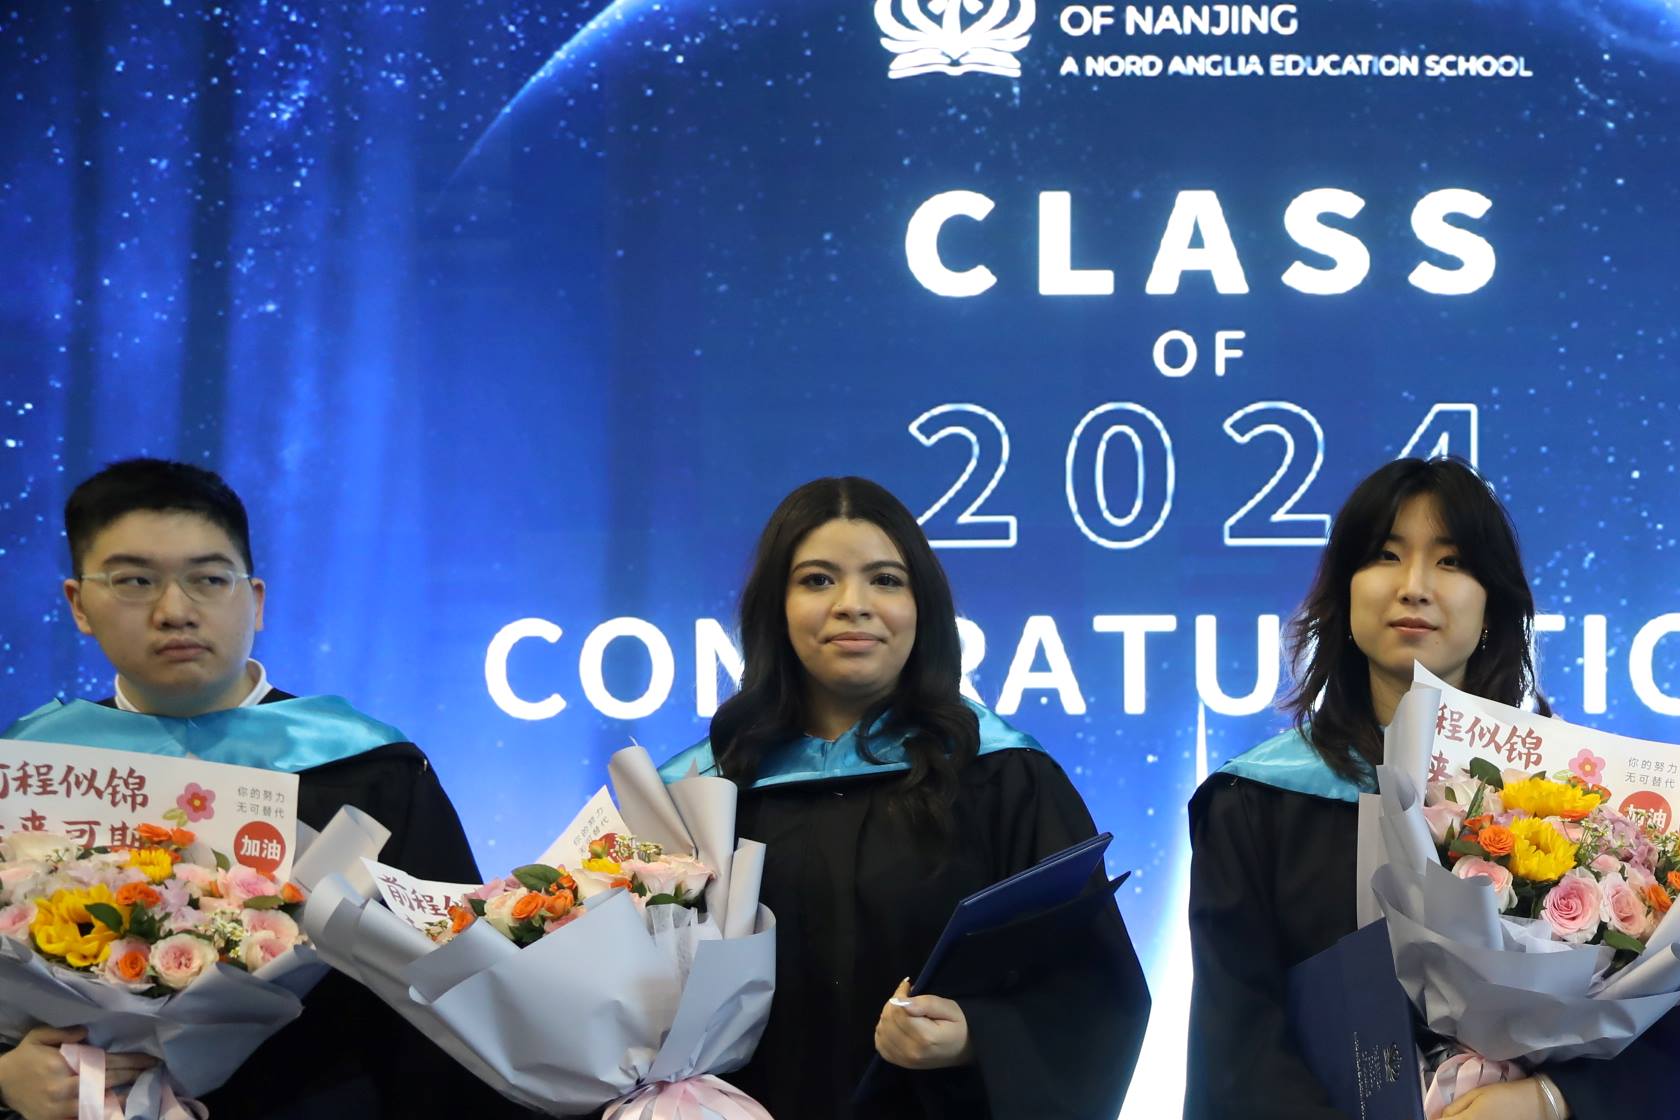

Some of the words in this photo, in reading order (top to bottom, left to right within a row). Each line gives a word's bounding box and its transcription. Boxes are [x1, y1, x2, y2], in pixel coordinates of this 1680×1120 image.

[1059, 4, 1114, 36] OF
[1124, 4, 1298, 36] NANJING
[1059, 55, 1080, 77] A
[1085, 55, 1163, 77] NORD
[1168, 55, 1264, 77] ANGLIA
[1270, 55, 1420, 77] EDUCATION
[1424, 55, 1533, 78] SCHOOL
[905, 187, 1497, 297] CLASS
[1152, 329, 1246, 378] OF
[1628, 757, 1678, 774] 你的努力
[0, 761, 149, 813] 程似锦
[1625, 772, 1677, 789] 无可替代
[240, 835, 281, 861] 加油
